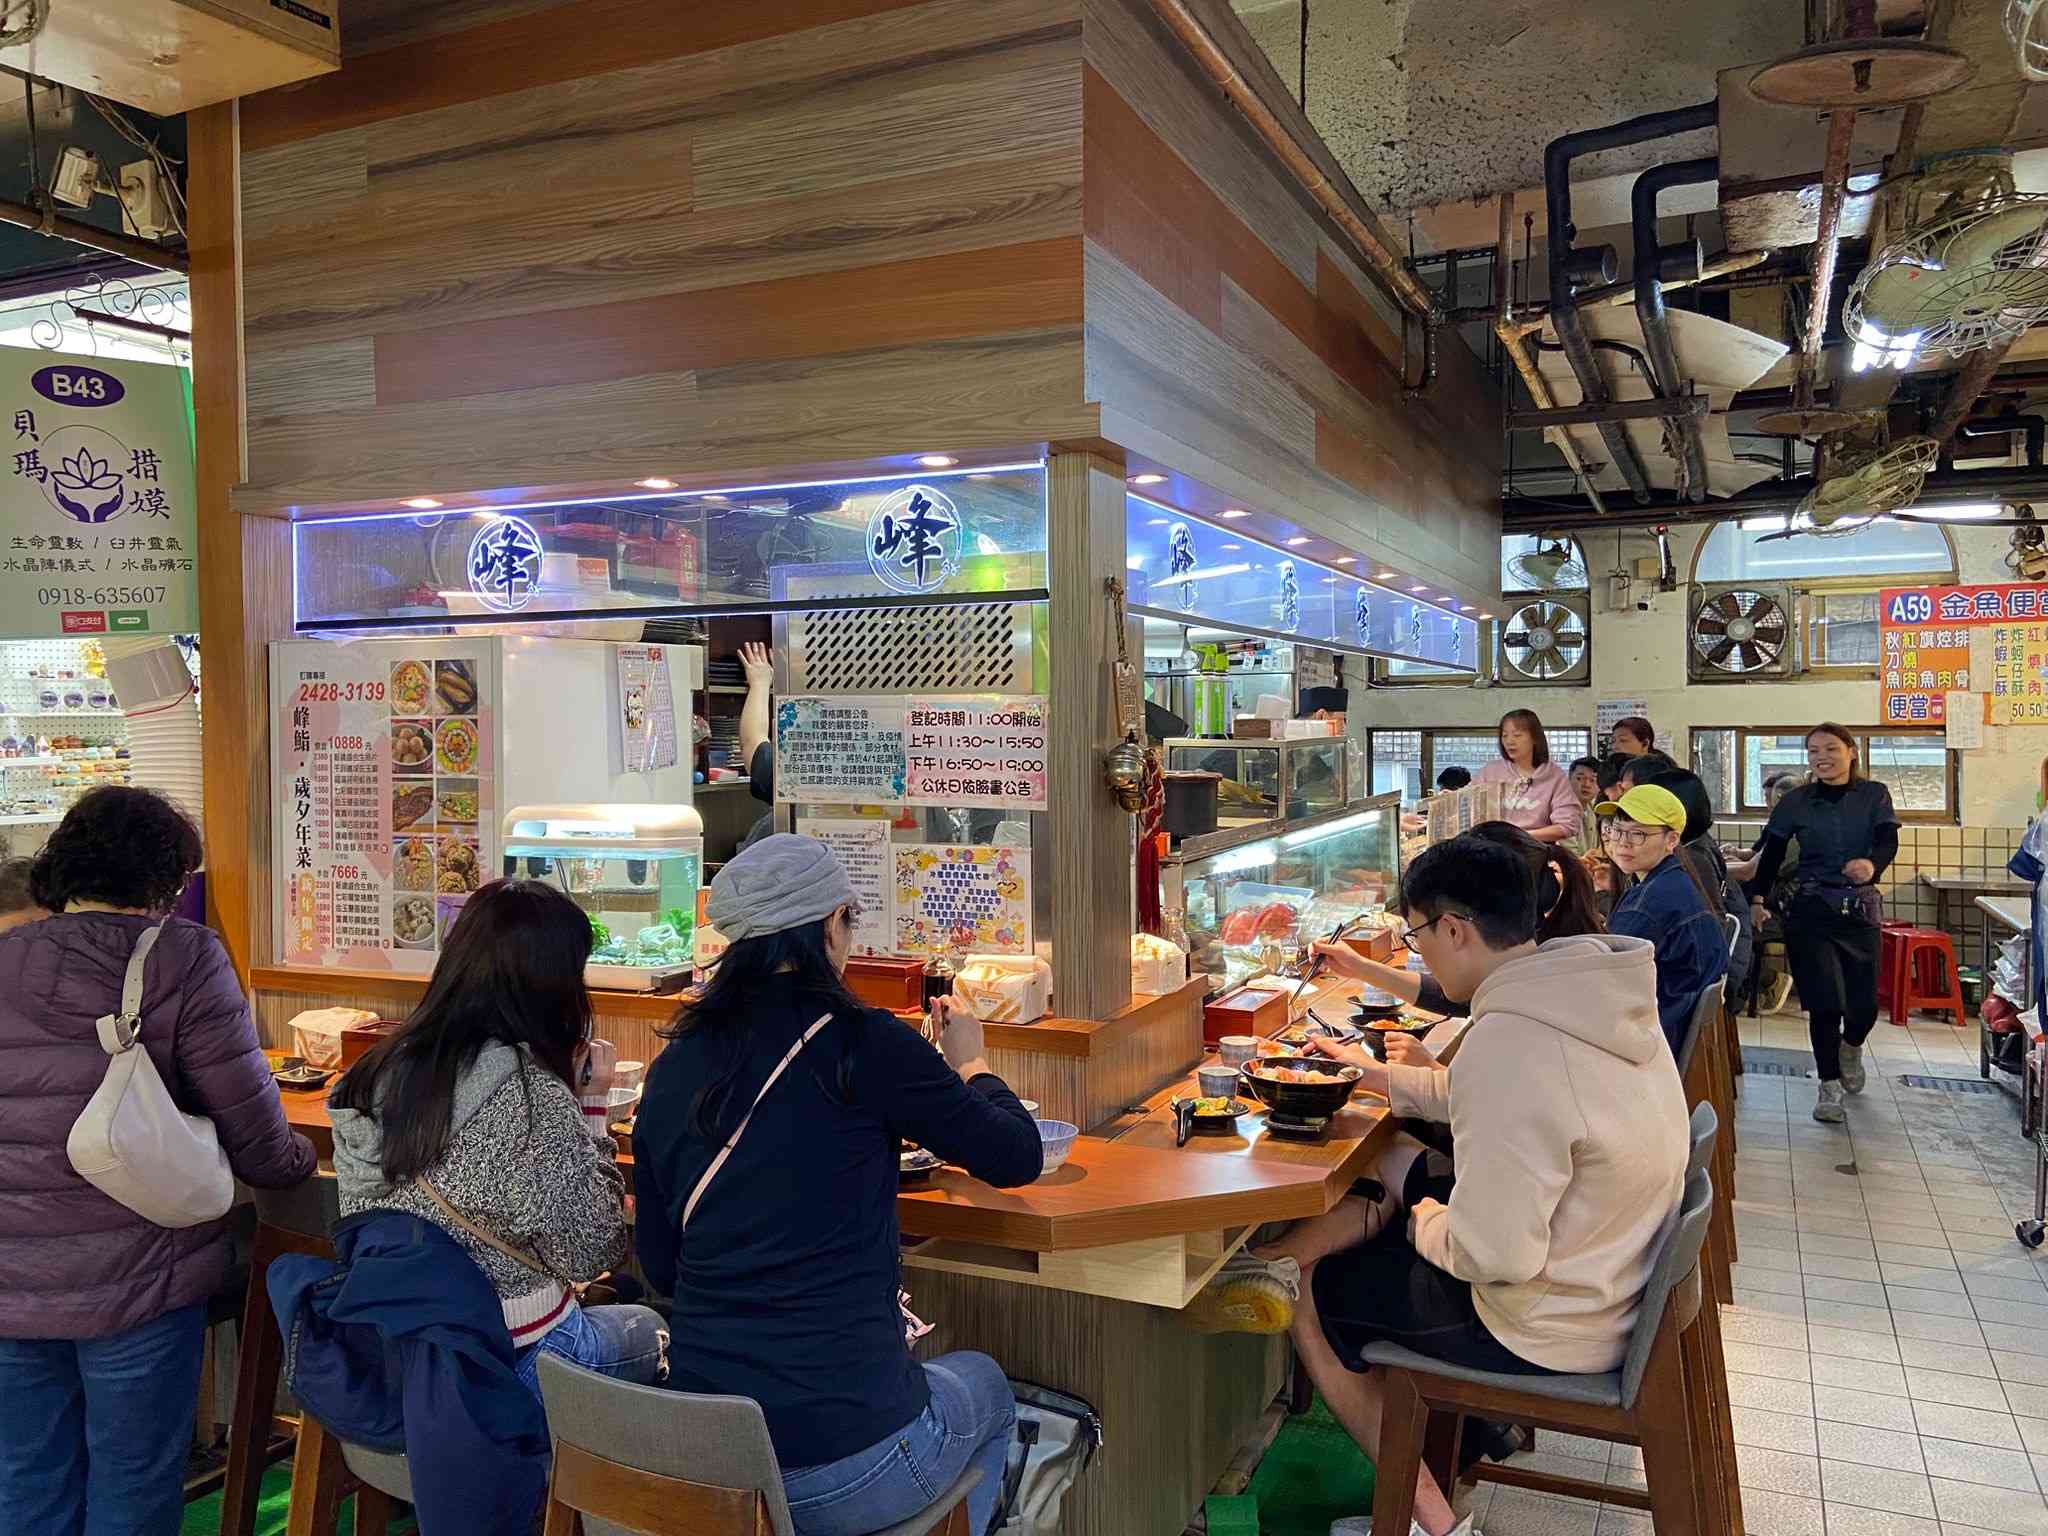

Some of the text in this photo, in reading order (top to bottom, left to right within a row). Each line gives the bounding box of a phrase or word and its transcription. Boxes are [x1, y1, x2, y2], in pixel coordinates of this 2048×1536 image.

[52, 373, 106, 400] B43
[10, 536, 83, 551] 生命靈數
[874, 491, 957, 588] 峰
[121, 558, 193, 573] 水晶礦石
[473, 520, 539, 609] 峰
[38, 587, 166, 605] 0918-635607
[1892, 597, 1931, 622] A59
[1885, 631, 1900, 689] 秋刀魚
[300, 682, 384, 702] 2428-3139
[1888, 692, 1929, 720] 便當
[2012, 702, 2042, 718] 50 50
[911, 711, 1042, 727] 登記時間11:00開始
[328, 736, 362, 750] 10888
[909, 736, 1044, 750] 上午11:30~15:50
[909, 756, 1044, 772] 下午16:50~19:00
[921, 778, 1032, 797] 公休日依臉書公告
[331, 865, 358, 879] 7666
